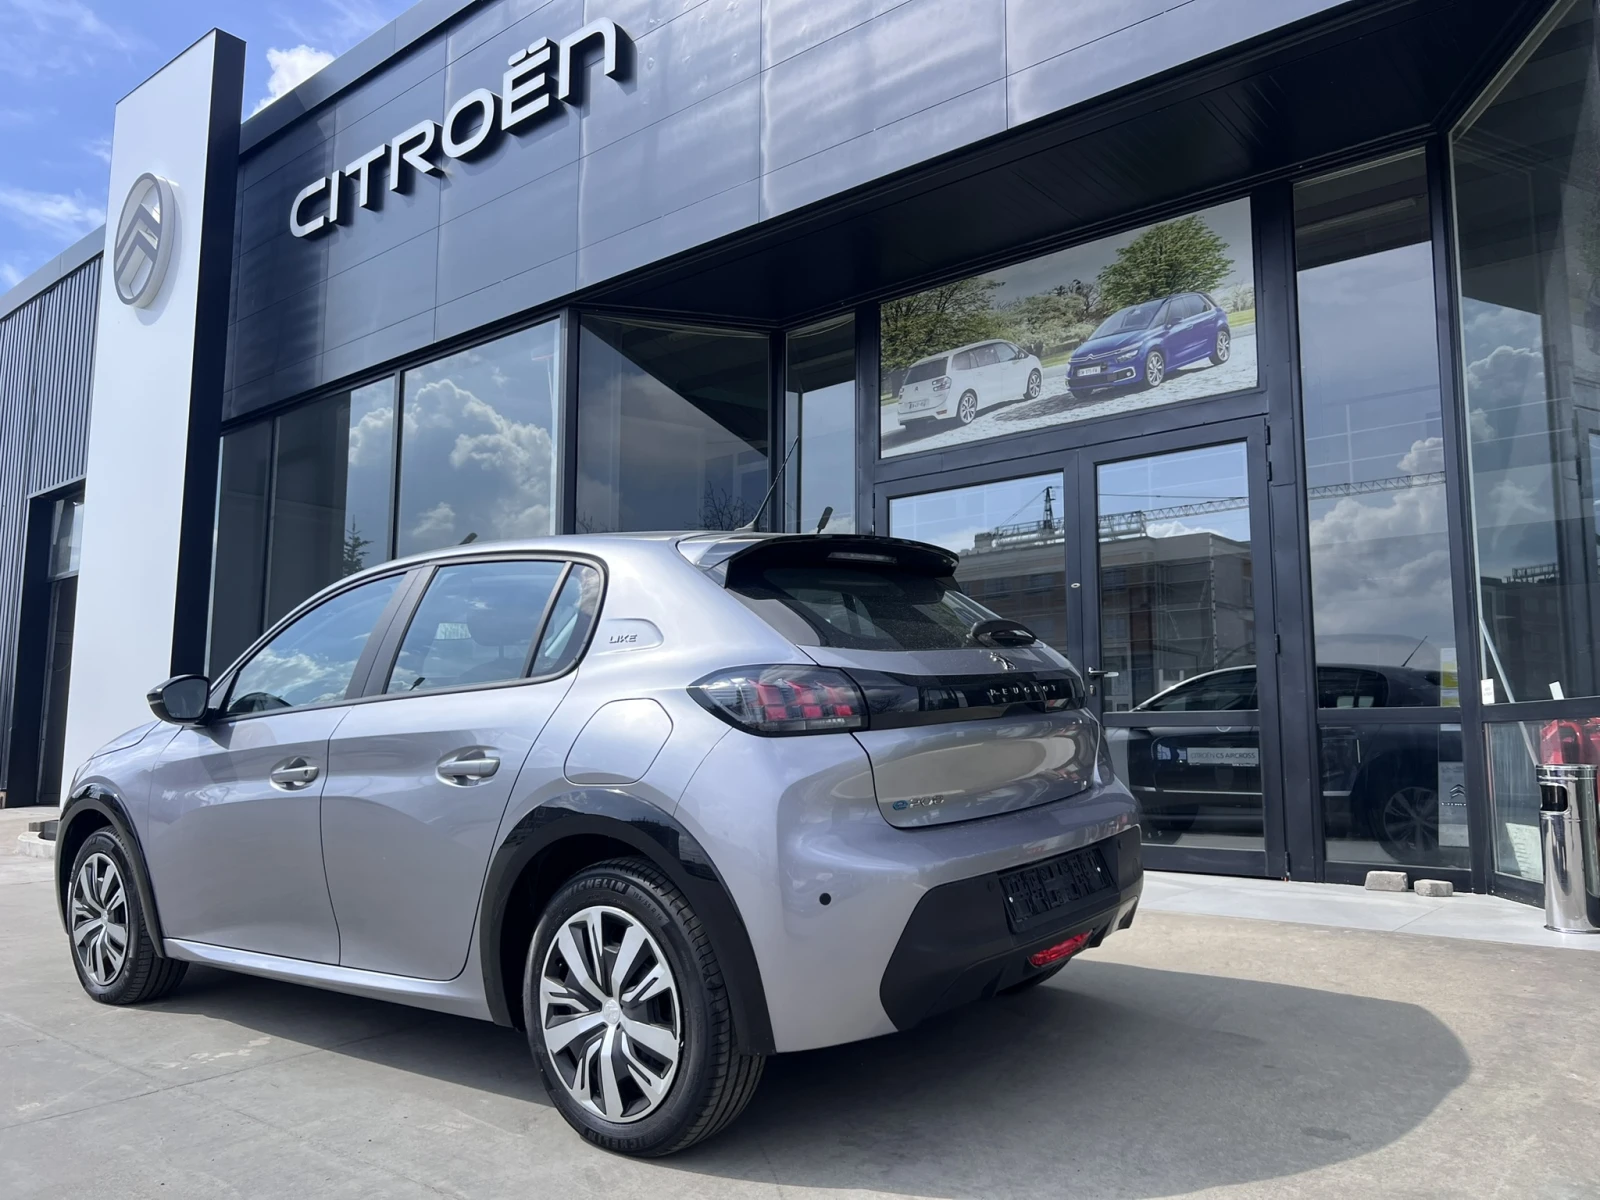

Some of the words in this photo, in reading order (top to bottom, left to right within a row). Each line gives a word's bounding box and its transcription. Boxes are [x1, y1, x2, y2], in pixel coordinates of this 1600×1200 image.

[609, 634, 637, 644] LIKE
[989, 685, 1056, 696] PEUGEOT
[563, 879, 626, 898] MICHELIN
